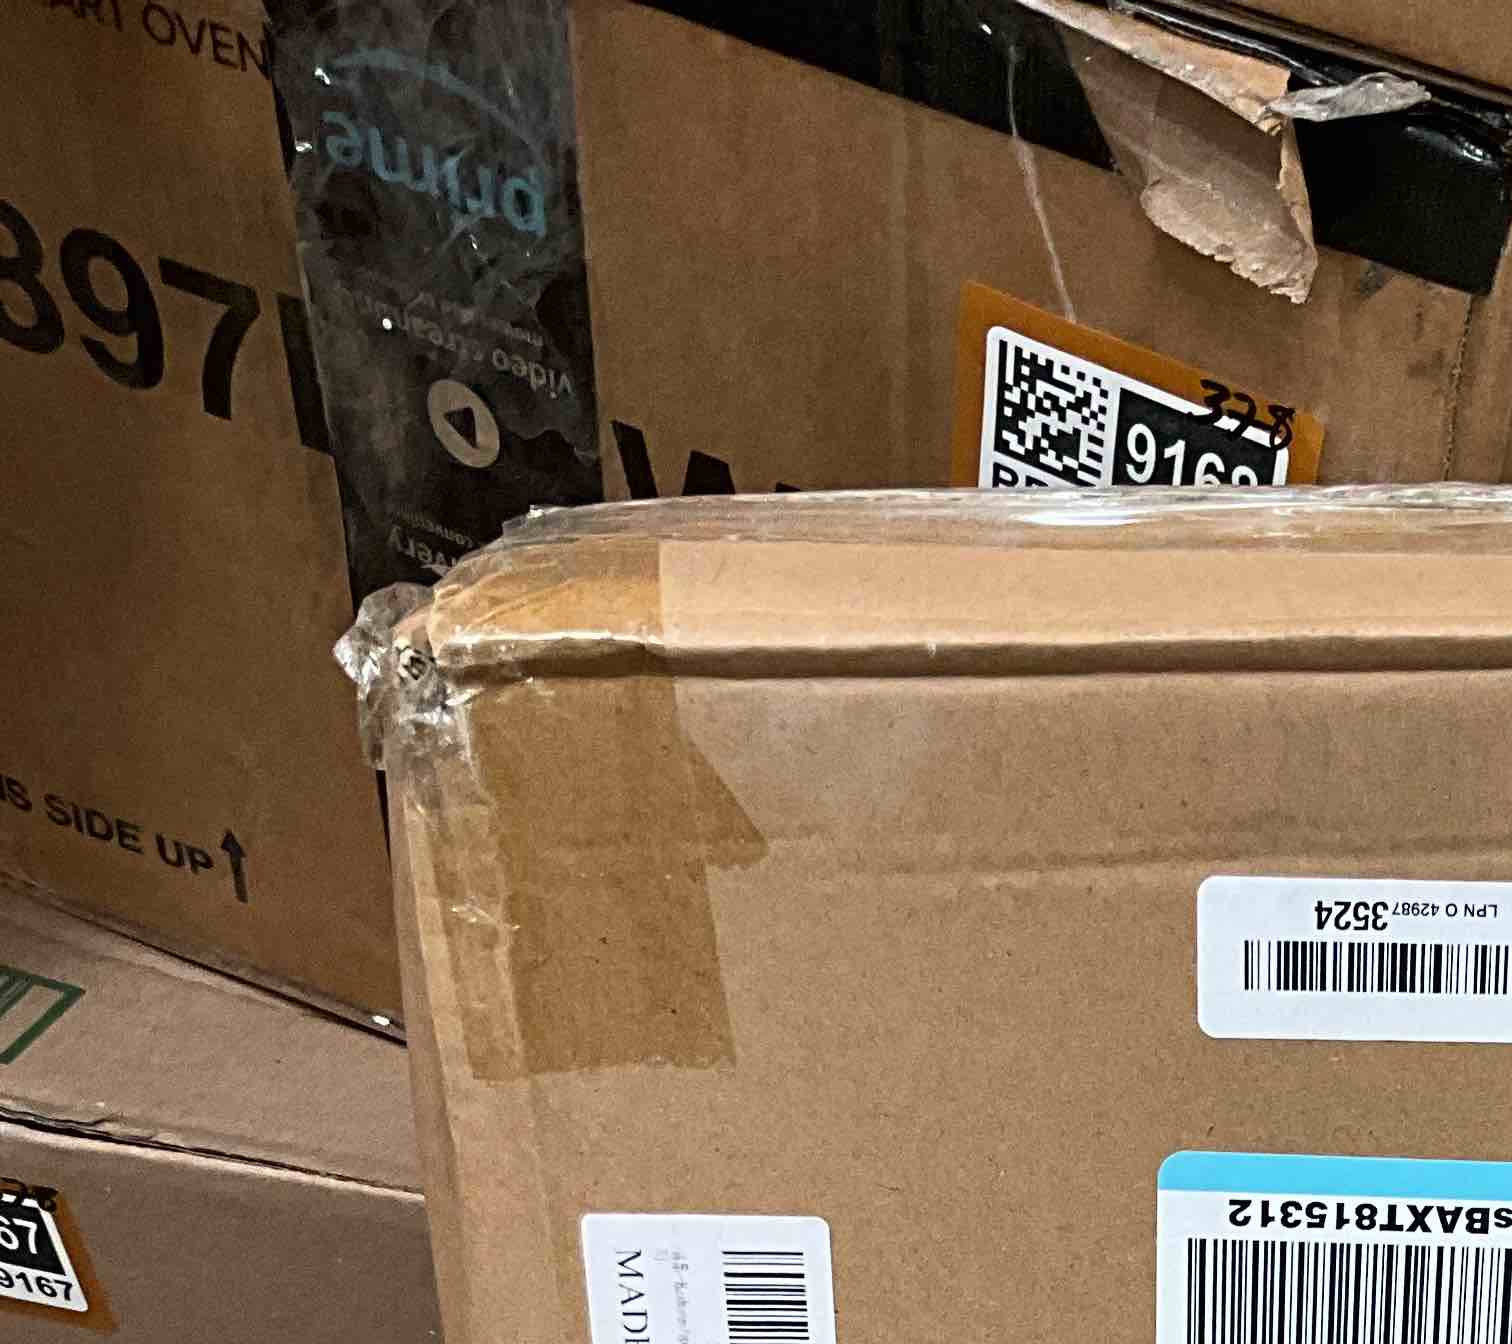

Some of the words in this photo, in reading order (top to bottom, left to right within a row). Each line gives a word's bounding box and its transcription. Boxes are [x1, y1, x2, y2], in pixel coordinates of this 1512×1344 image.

[142, 3, 272, 80] OVEN
[322, 110, 547, 237] prime
[43, 792, 145, 855] SIDE
[155, 832, 214, 875] UP
[1463, 903, 1499, 918] LPN
